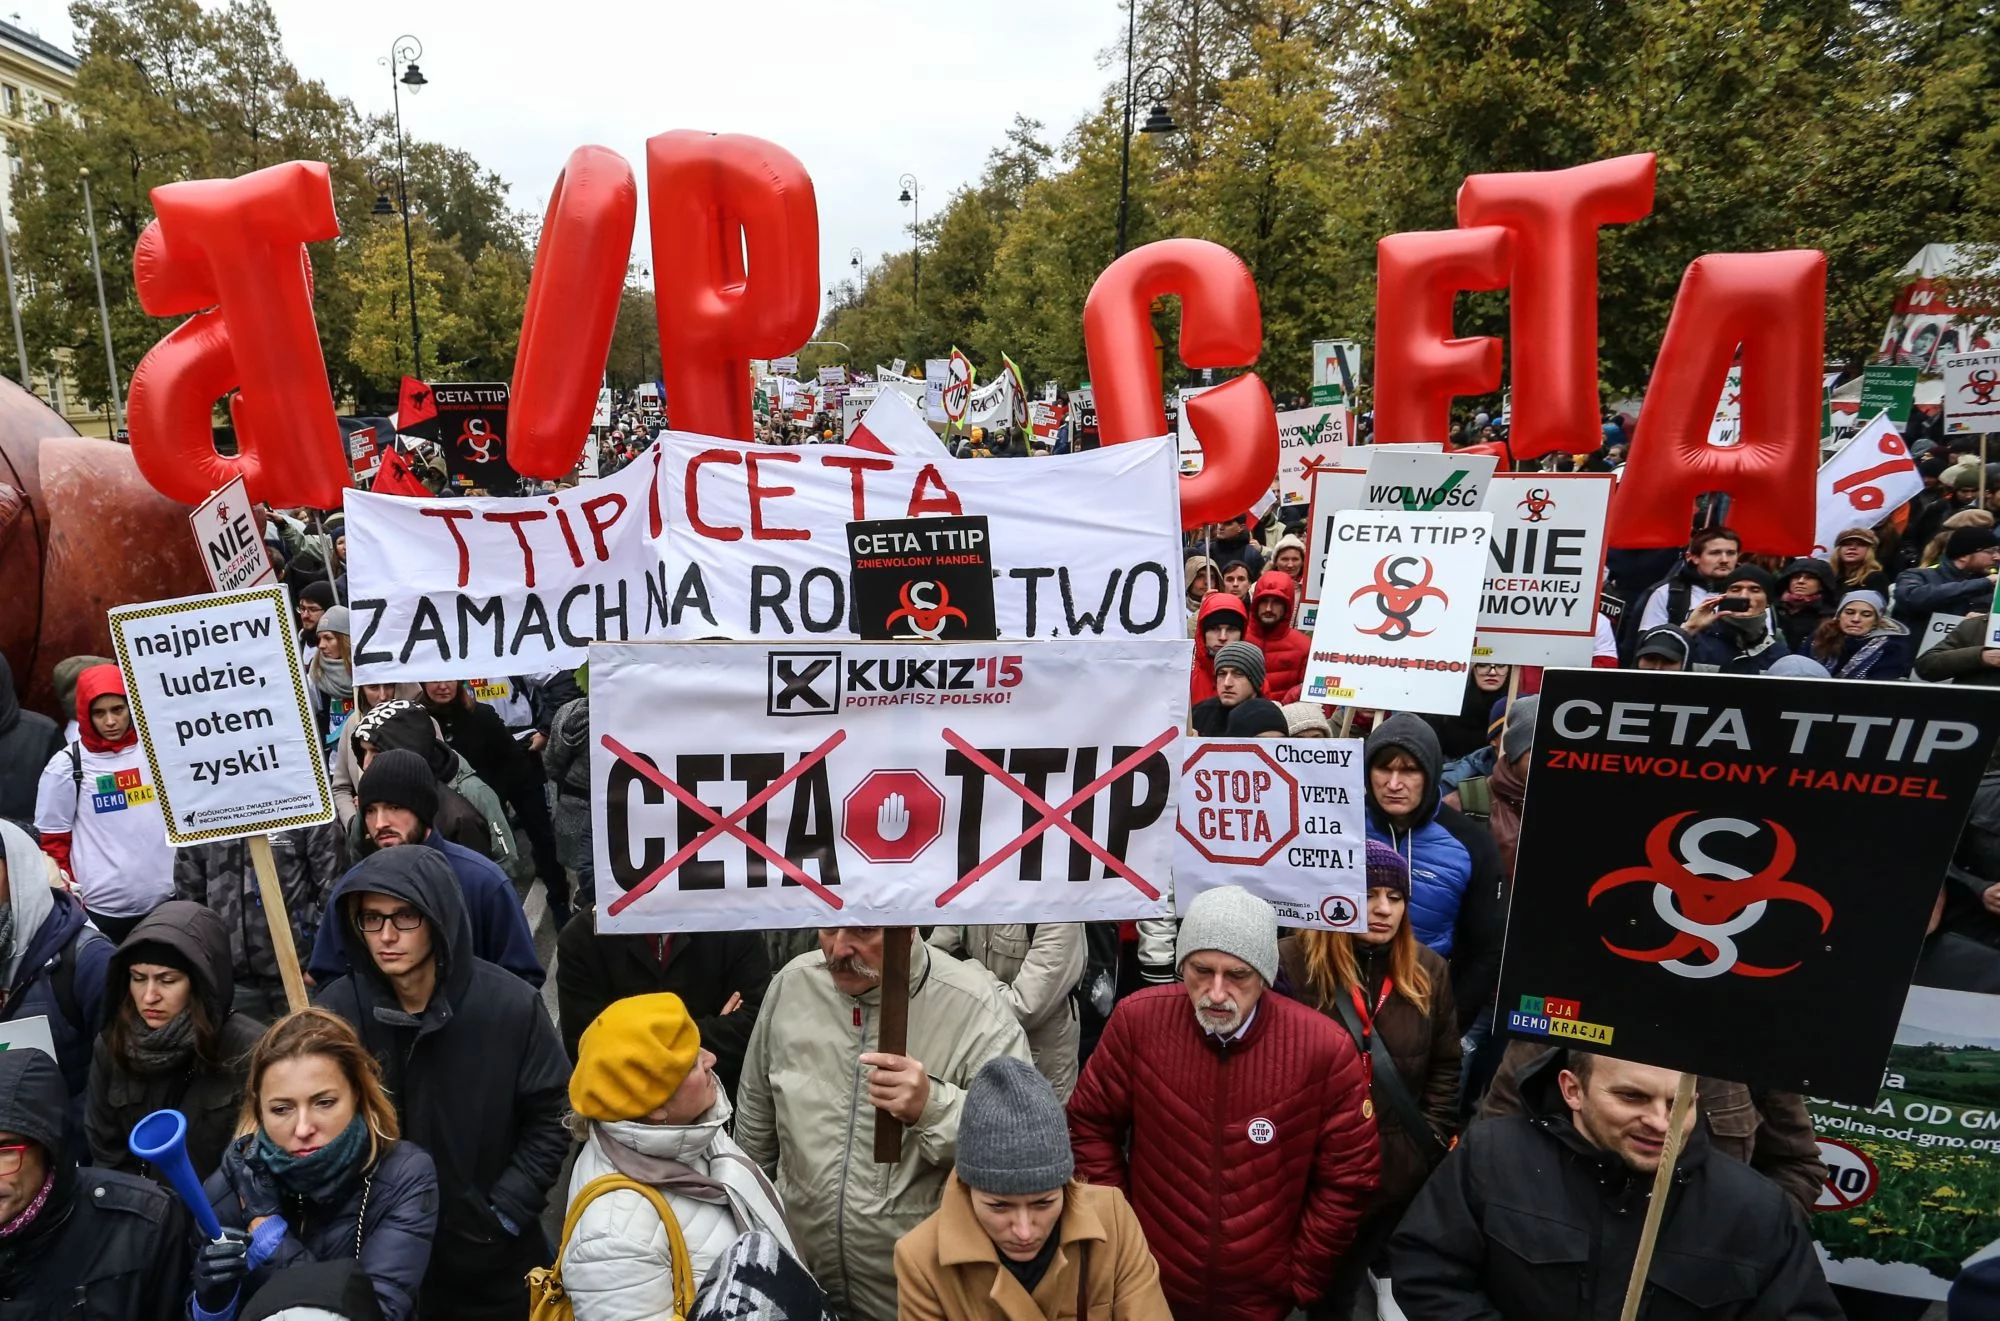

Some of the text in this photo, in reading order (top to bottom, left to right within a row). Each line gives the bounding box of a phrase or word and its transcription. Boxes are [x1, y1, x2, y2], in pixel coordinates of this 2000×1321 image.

[1946, 358, 1981, 369] CETA
[436, 391, 506, 403] CETA TTIP
[1280, 418, 1342, 437] WOLNOŚĆ
[1281, 437, 1305, 449] DLA
[685, 449, 963, 541] CETA
[1369, 484, 1478, 507] WOLNOŚĆ
[208, 513, 255, 571] NIE
[853, 529, 984, 554] CETA TTIP
[1338, 524, 1402, 543] CETA
[218, 543, 258, 582] CHCETAKIEJ
[857, 554, 984, 569] ZNIEWOLONY HANDEL
[1489, 528, 1586, 575] NIE
[1482, 578, 1581, 594] HCETAKIEJ
[351, 579, 629, 666] ZAMACH
[645, 560, 718, 634] NA
[134, 616, 271, 659] najpierw
[1933, 621, 1957, 634] CE
[1313, 650, 1339, 664] NIE
[1345, 653, 1409, 673] KUPUJĘ
[160, 662, 267, 697] ludzie,
[847, 655, 1024, 692] KUKIZ'15
[846, 691, 1012, 708] POTRAFISZ POLSKO!
[1310, 687, 1352, 698] DEMOKRACJA
[175, 707, 273, 746] potem
[1552, 699, 1980, 766] CETA TTIP
[189, 744, 280, 785] zyski!
[1275, 744, 1353, 767] Chcemy
[1194, 769, 1272, 804] STOP
[1546, 750, 1948, 800] ZNIEWOLONY HANDEL
[197, 794, 312, 817] OGÓLNOPOLSKI ZWIĄZEK ZAWODOWY
[1301, 785, 1350, 804] VETA
[200, 815, 232, 825] INICJATYWA
[233, 807, 276, 820] PRACOWNICZA
[606, 745, 1171, 893] CETA TTIP
[1198, 807, 1273, 843] CETA
[1304, 816, 1343, 835] dla
[1288, 847, 1354, 869] CETA!
[1265, 899, 1311, 909] towarzyszenie
[1525, 1000, 1573, 1017] AKCJA
[1513, 1014, 1606, 1041] DEMOKRACJA
[1904, 1102, 1953, 1125] OD
[1252, 1128, 1270, 1136] STOP
